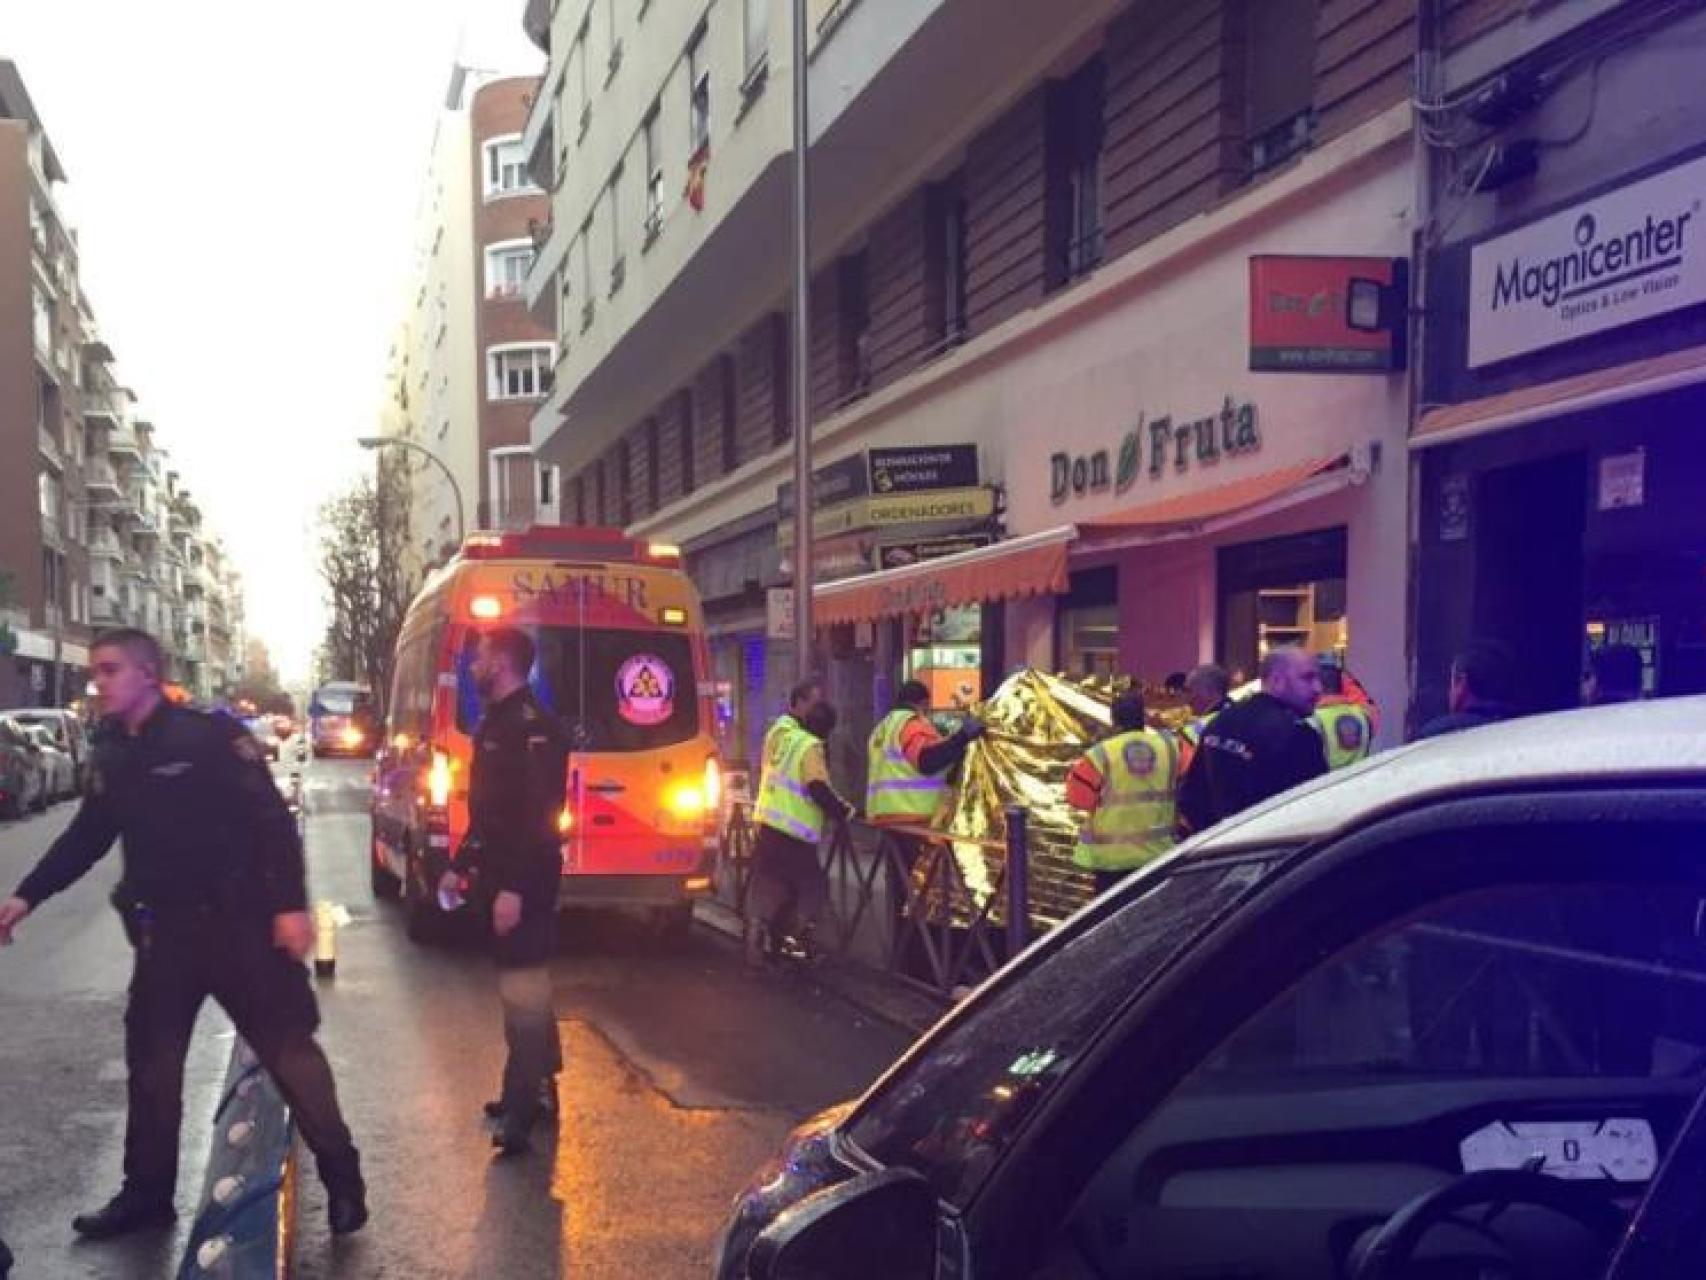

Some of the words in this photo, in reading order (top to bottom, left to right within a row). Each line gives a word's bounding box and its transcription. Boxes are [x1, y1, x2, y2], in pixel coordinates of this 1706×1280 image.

[1491, 211, 1691, 311] Magnicenter
[1050, 450, 1110, 505] Don
[1148, 393, 1261, 480] Fruta
[512, 570, 648, 609] SAMUR
